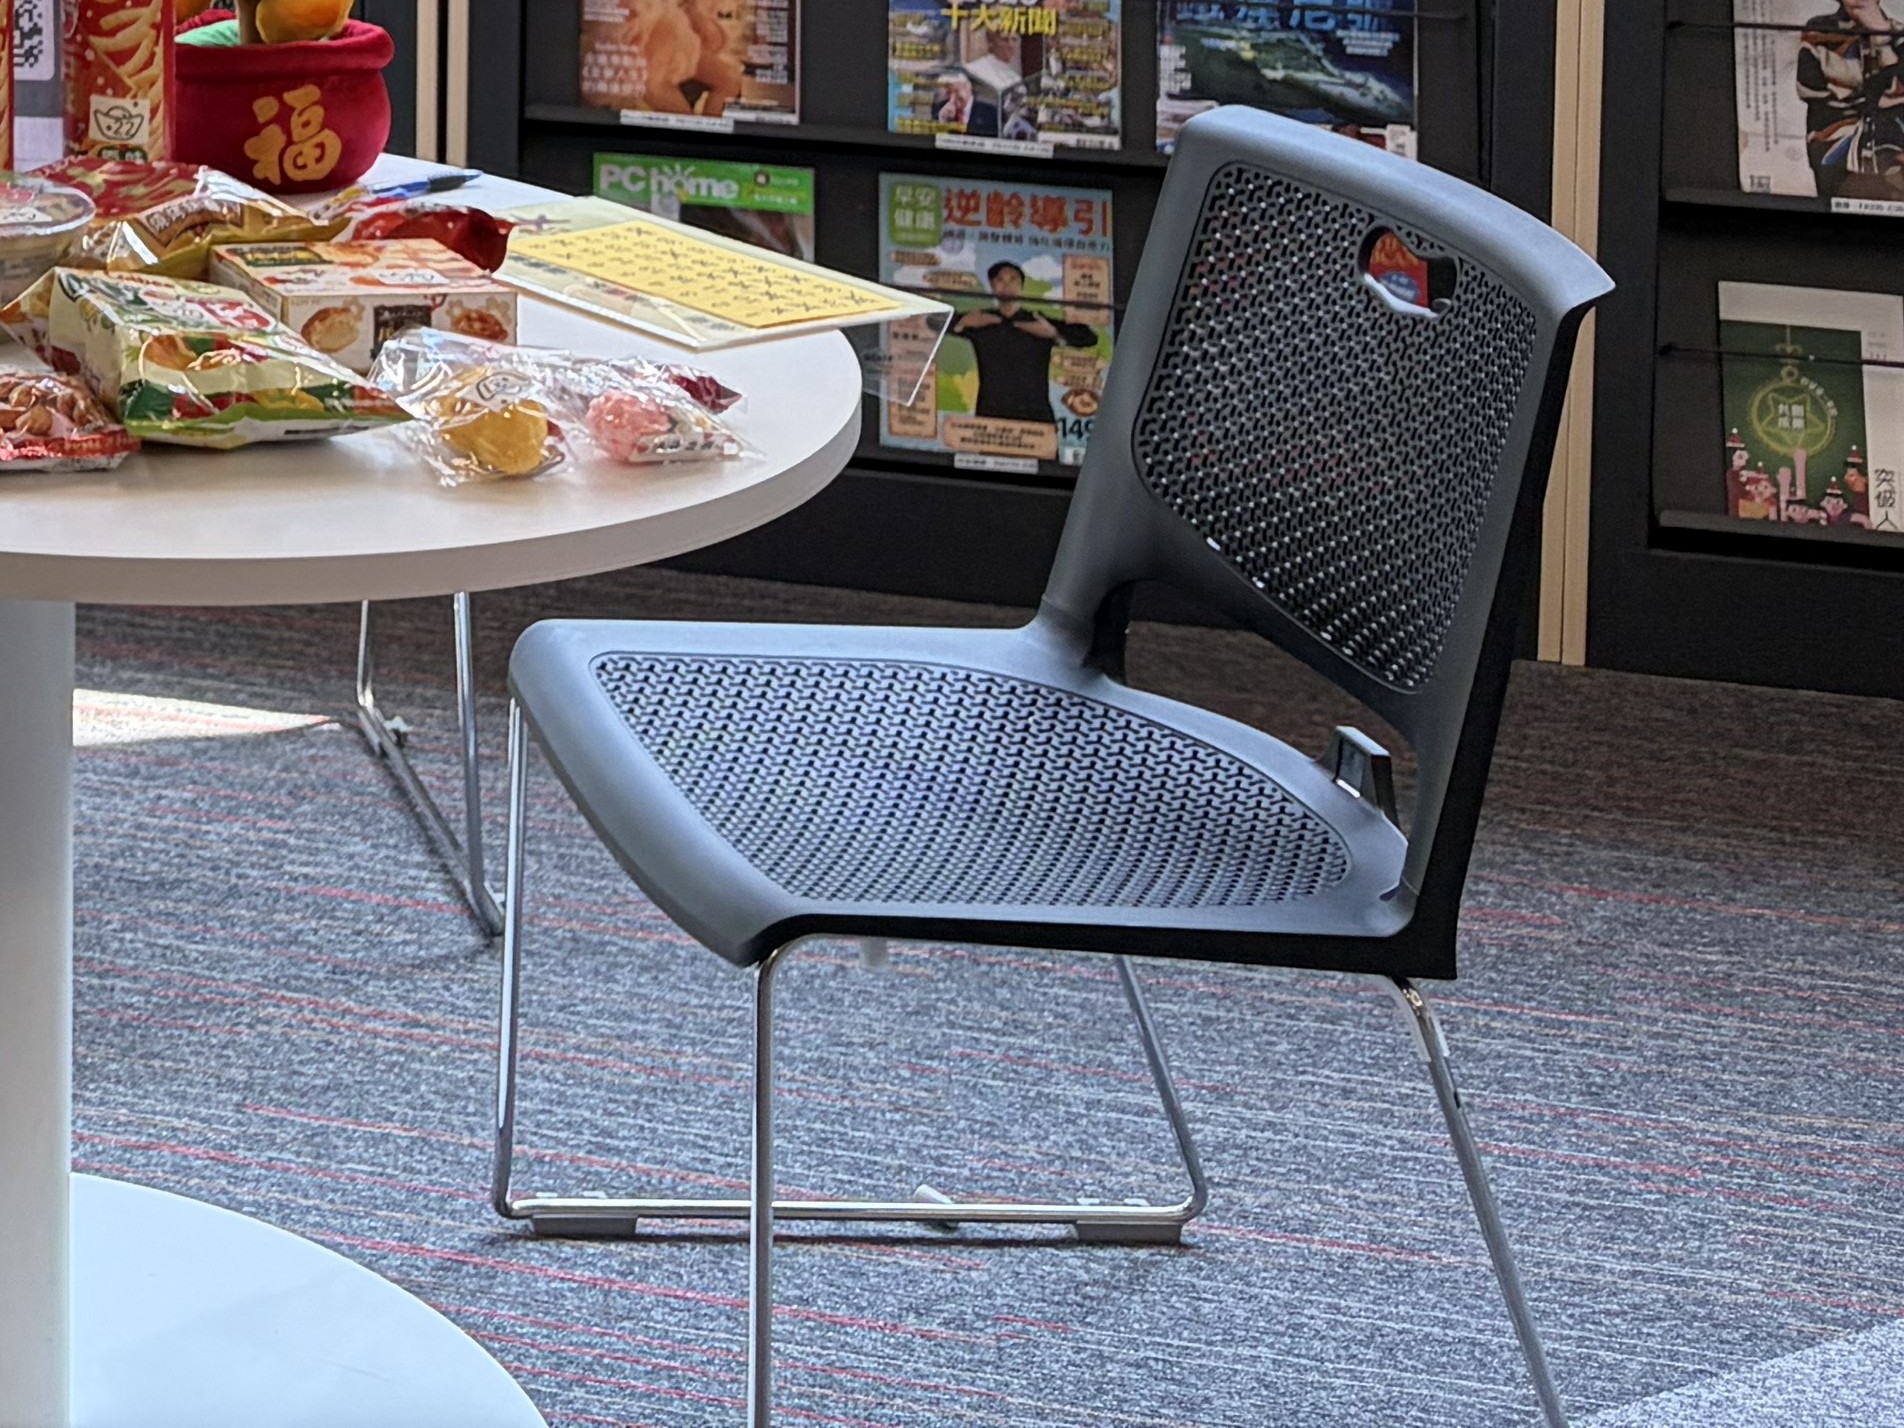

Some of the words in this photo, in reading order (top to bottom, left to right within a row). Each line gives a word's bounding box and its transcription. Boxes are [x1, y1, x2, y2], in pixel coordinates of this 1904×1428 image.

[941, 3, 1059, 36] 十大新聞
[114, 119, 135, 136] 22
[243, 83, 343, 186] 福
[599, 163, 646, 194] PC
[650, 165, 740, 200] home
[895, 185, 936, 207] 早安
[894, 209, 936, 231] 健康
[944, 187, 1109, 238] 逆齡導引
